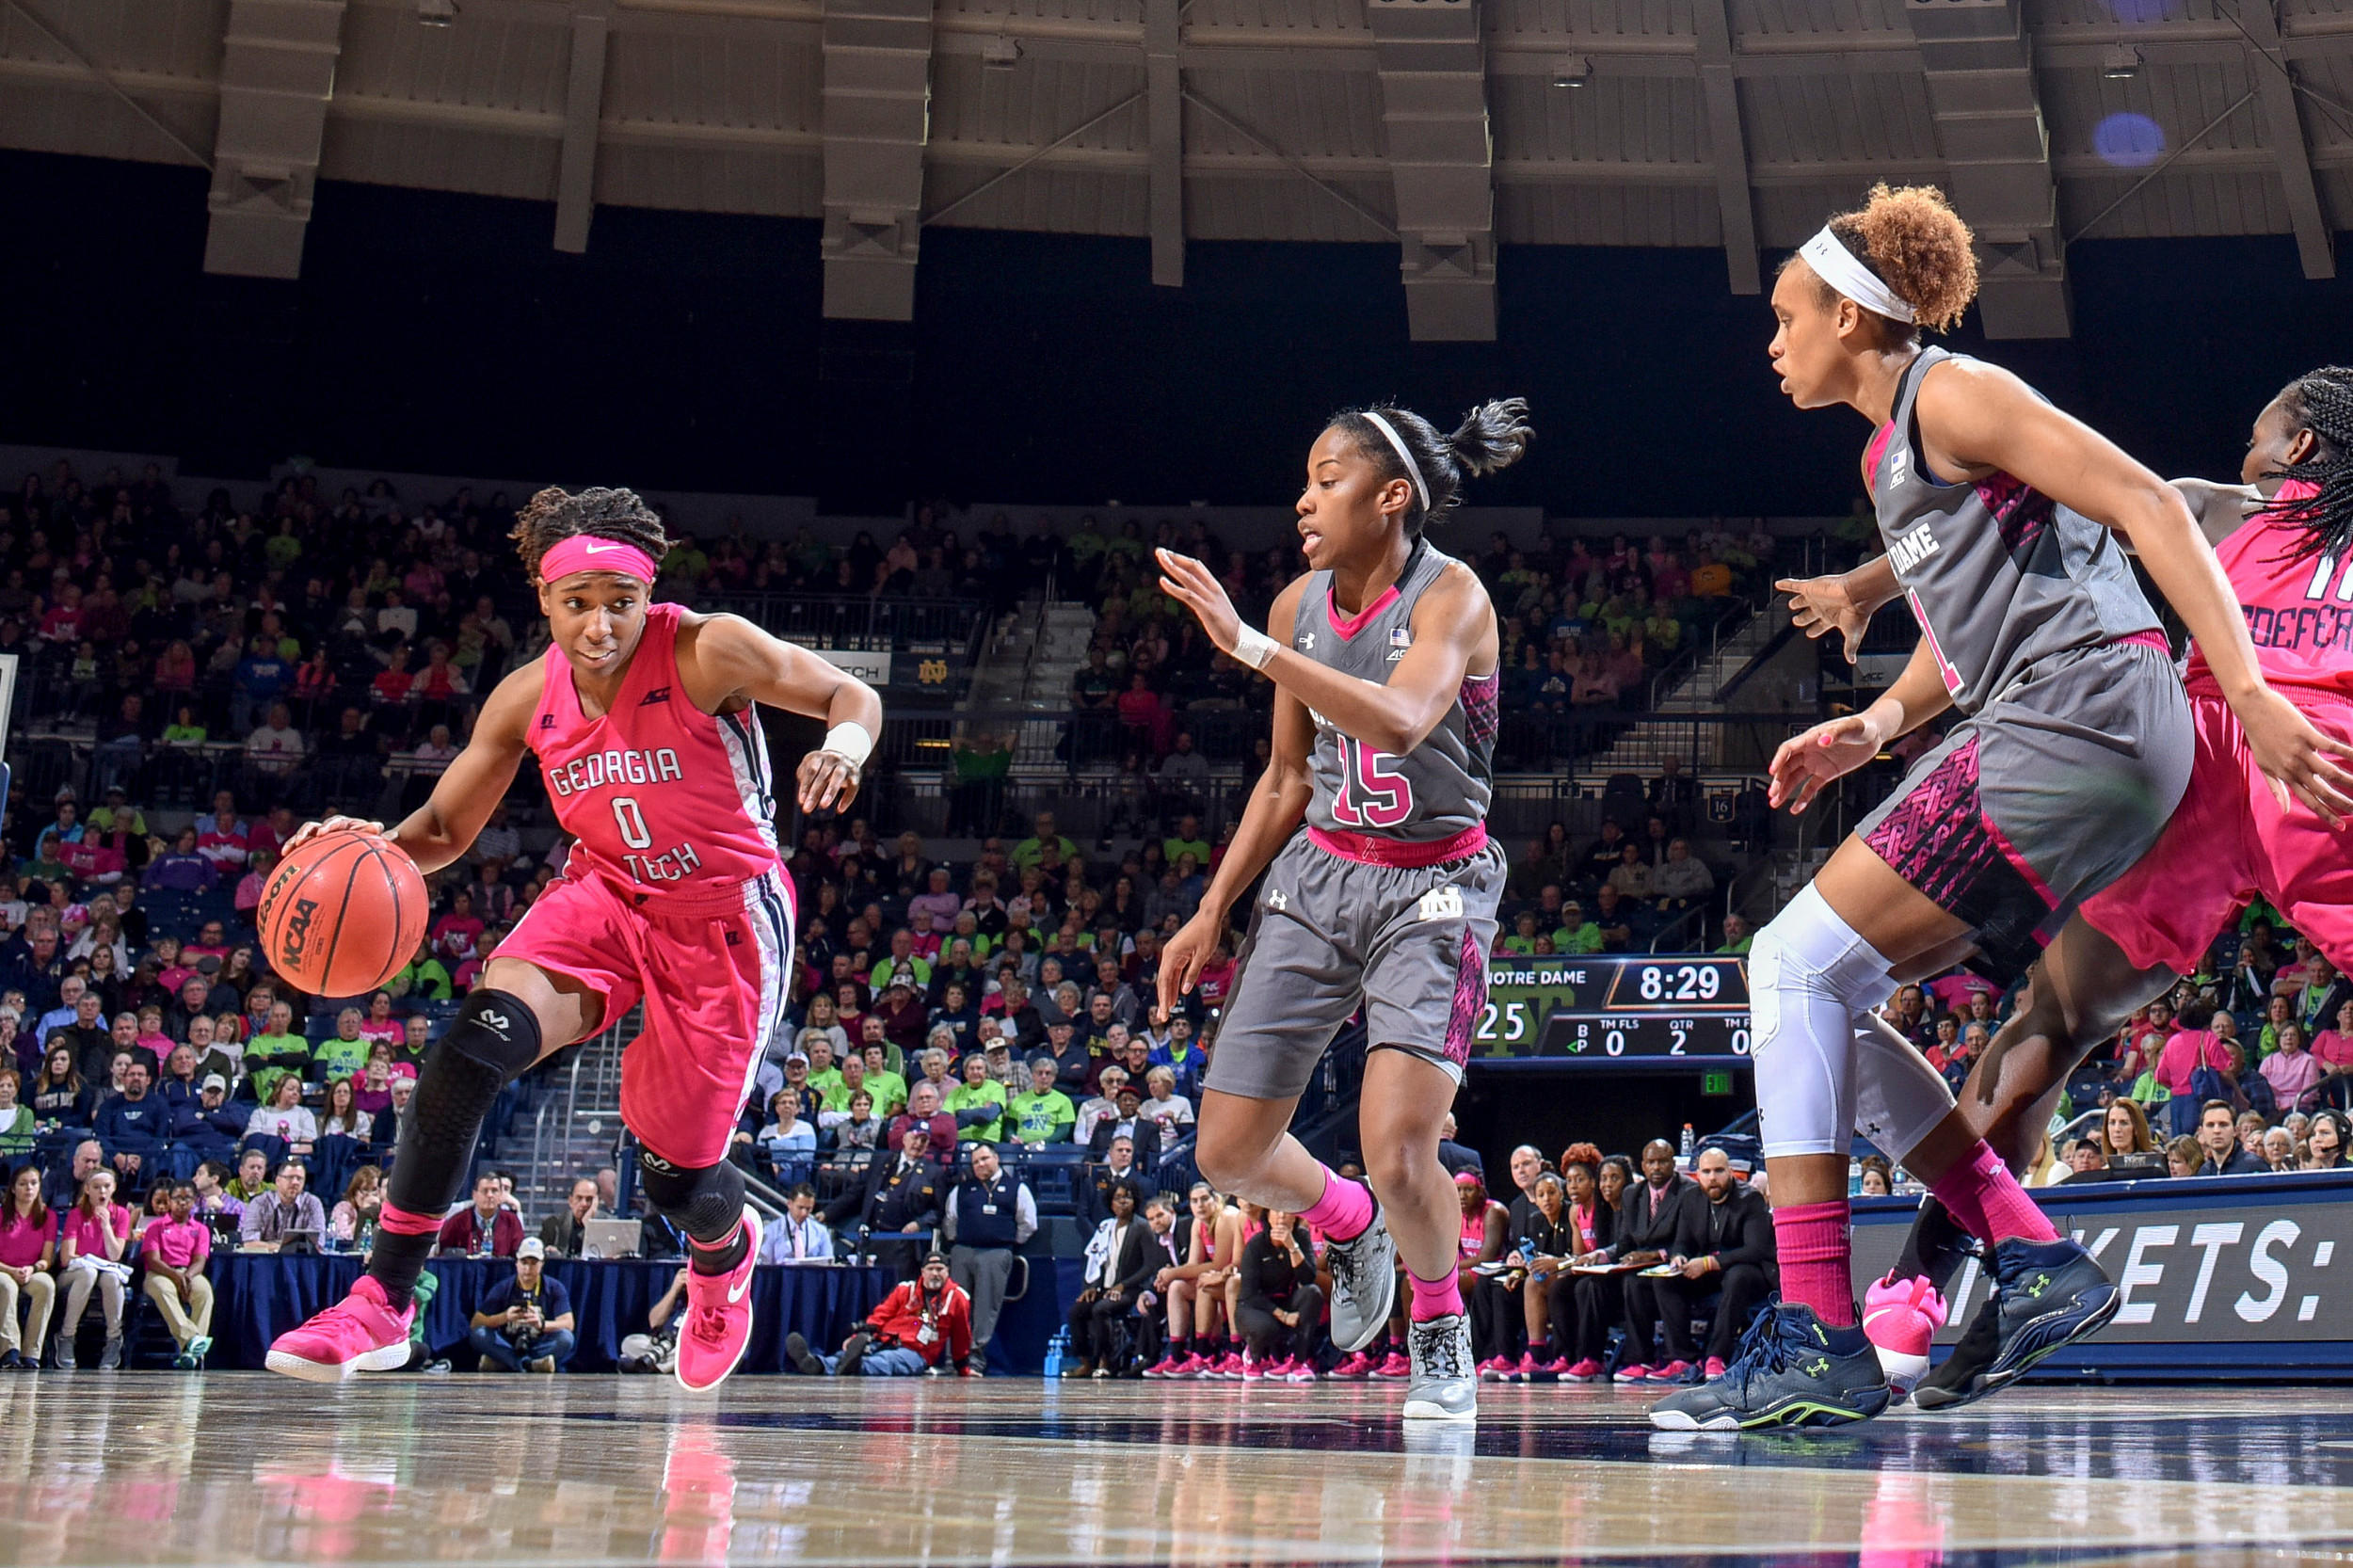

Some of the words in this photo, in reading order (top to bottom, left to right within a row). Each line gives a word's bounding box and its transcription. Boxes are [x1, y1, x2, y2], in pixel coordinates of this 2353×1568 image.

[1908, 585, 1964, 696] 1
[1386, 649, 1407, 661] AC
[550, 748, 682, 796] GEORGIA
[1332, 733, 1414, 827] 15
[1715, 801, 1728, 812] 16
[611, 796, 652, 849] 0
[623, 842, 701, 885] TECH
[282, 898, 319, 973] NCAA
[1486, 971, 1535, 985] NOTRE
[1541, 970, 1586, 984] DAME
[1641, 966, 1720, 1000] 8:29
[1477, 1002, 1525, 1041] 25
[1578, 1024, 1588, 1037] B
[1601, 1019, 1615, 1030] TM
[1619, 1019, 1639, 1030] FLS
[1670, 1020, 1693, 1031] QTR
[1724, 1018, 1739, 1028] TM
[1577, 1039, 1588, 1052] P
[1606, 1031, 1625, 1056] 0
[1671, 1031, 1686, 1056] 2
[1732, 1030, 1750, 1055] 0
[1705, 1074, 1728, 1093] EXIT
